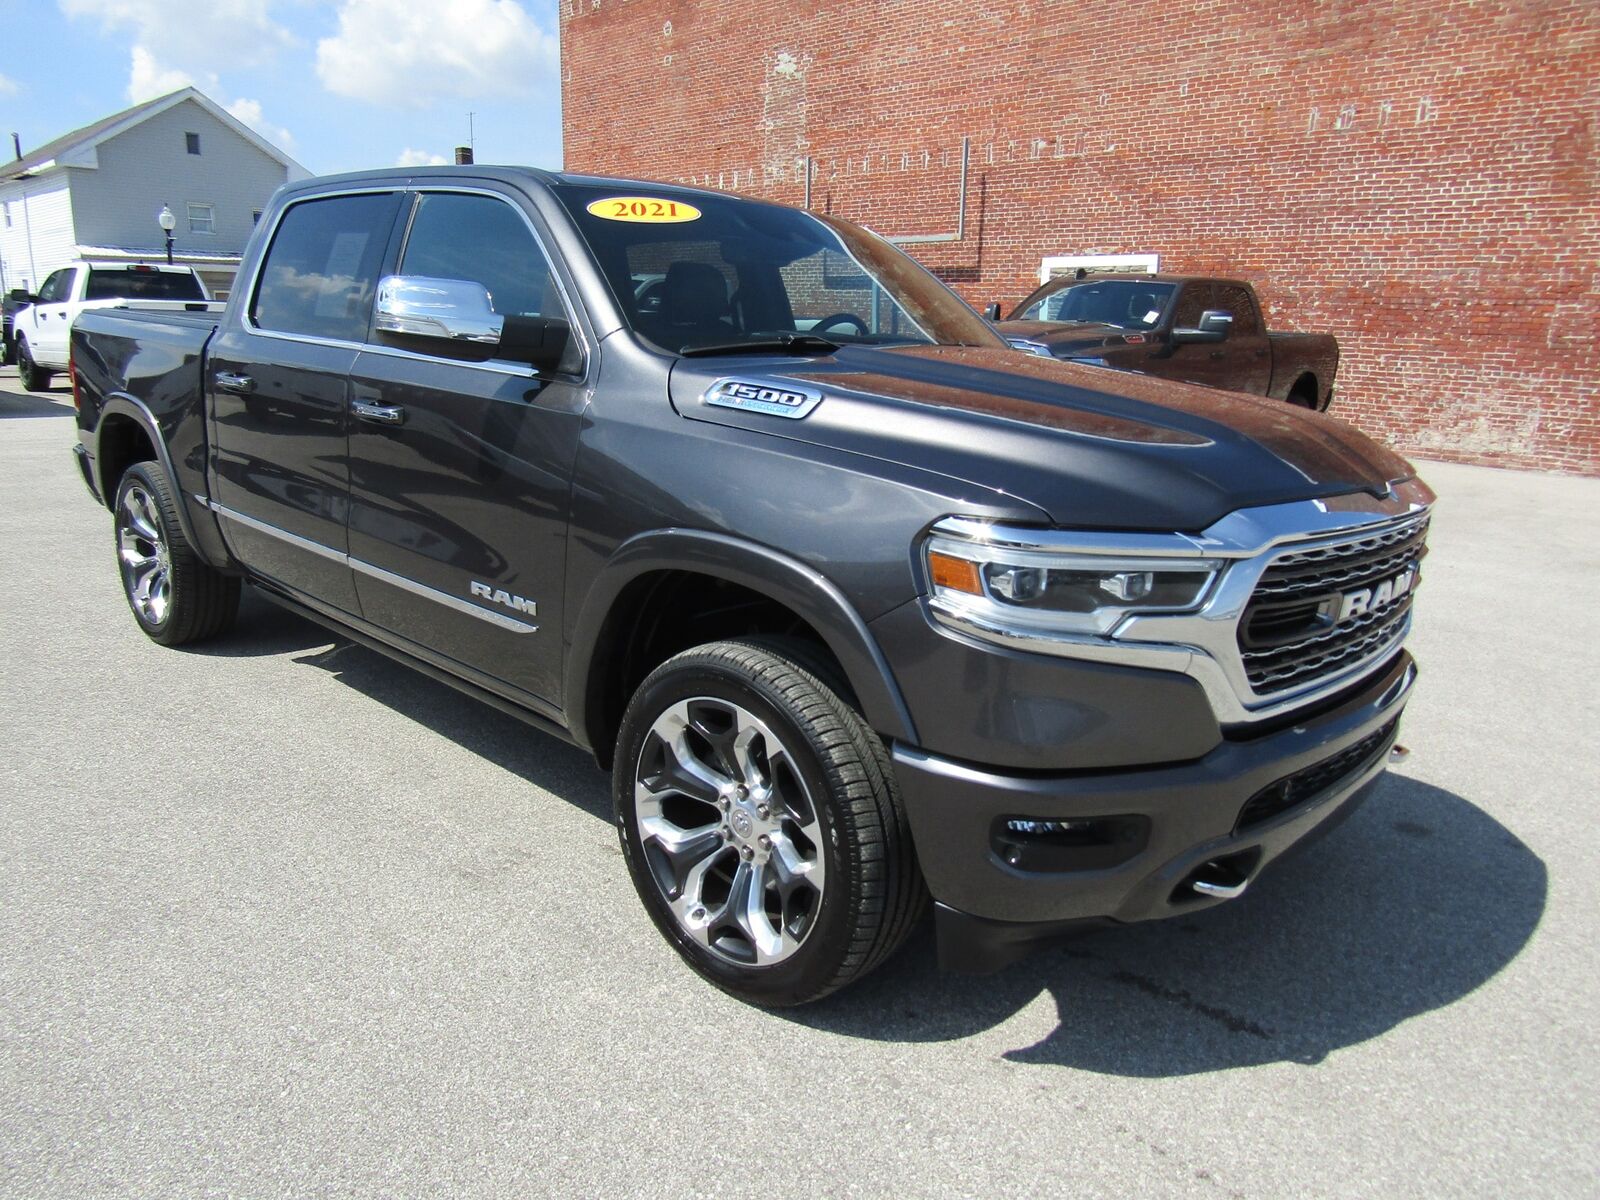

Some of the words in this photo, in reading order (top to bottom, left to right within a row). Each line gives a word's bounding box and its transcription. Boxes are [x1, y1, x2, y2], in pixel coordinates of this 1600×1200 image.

[613, 202, 677, 217] 2021
[725, 383, 803, 406] 1500
[470, 580, 537, 617] RAM
[1339, 570, 1413, 621] RAM
